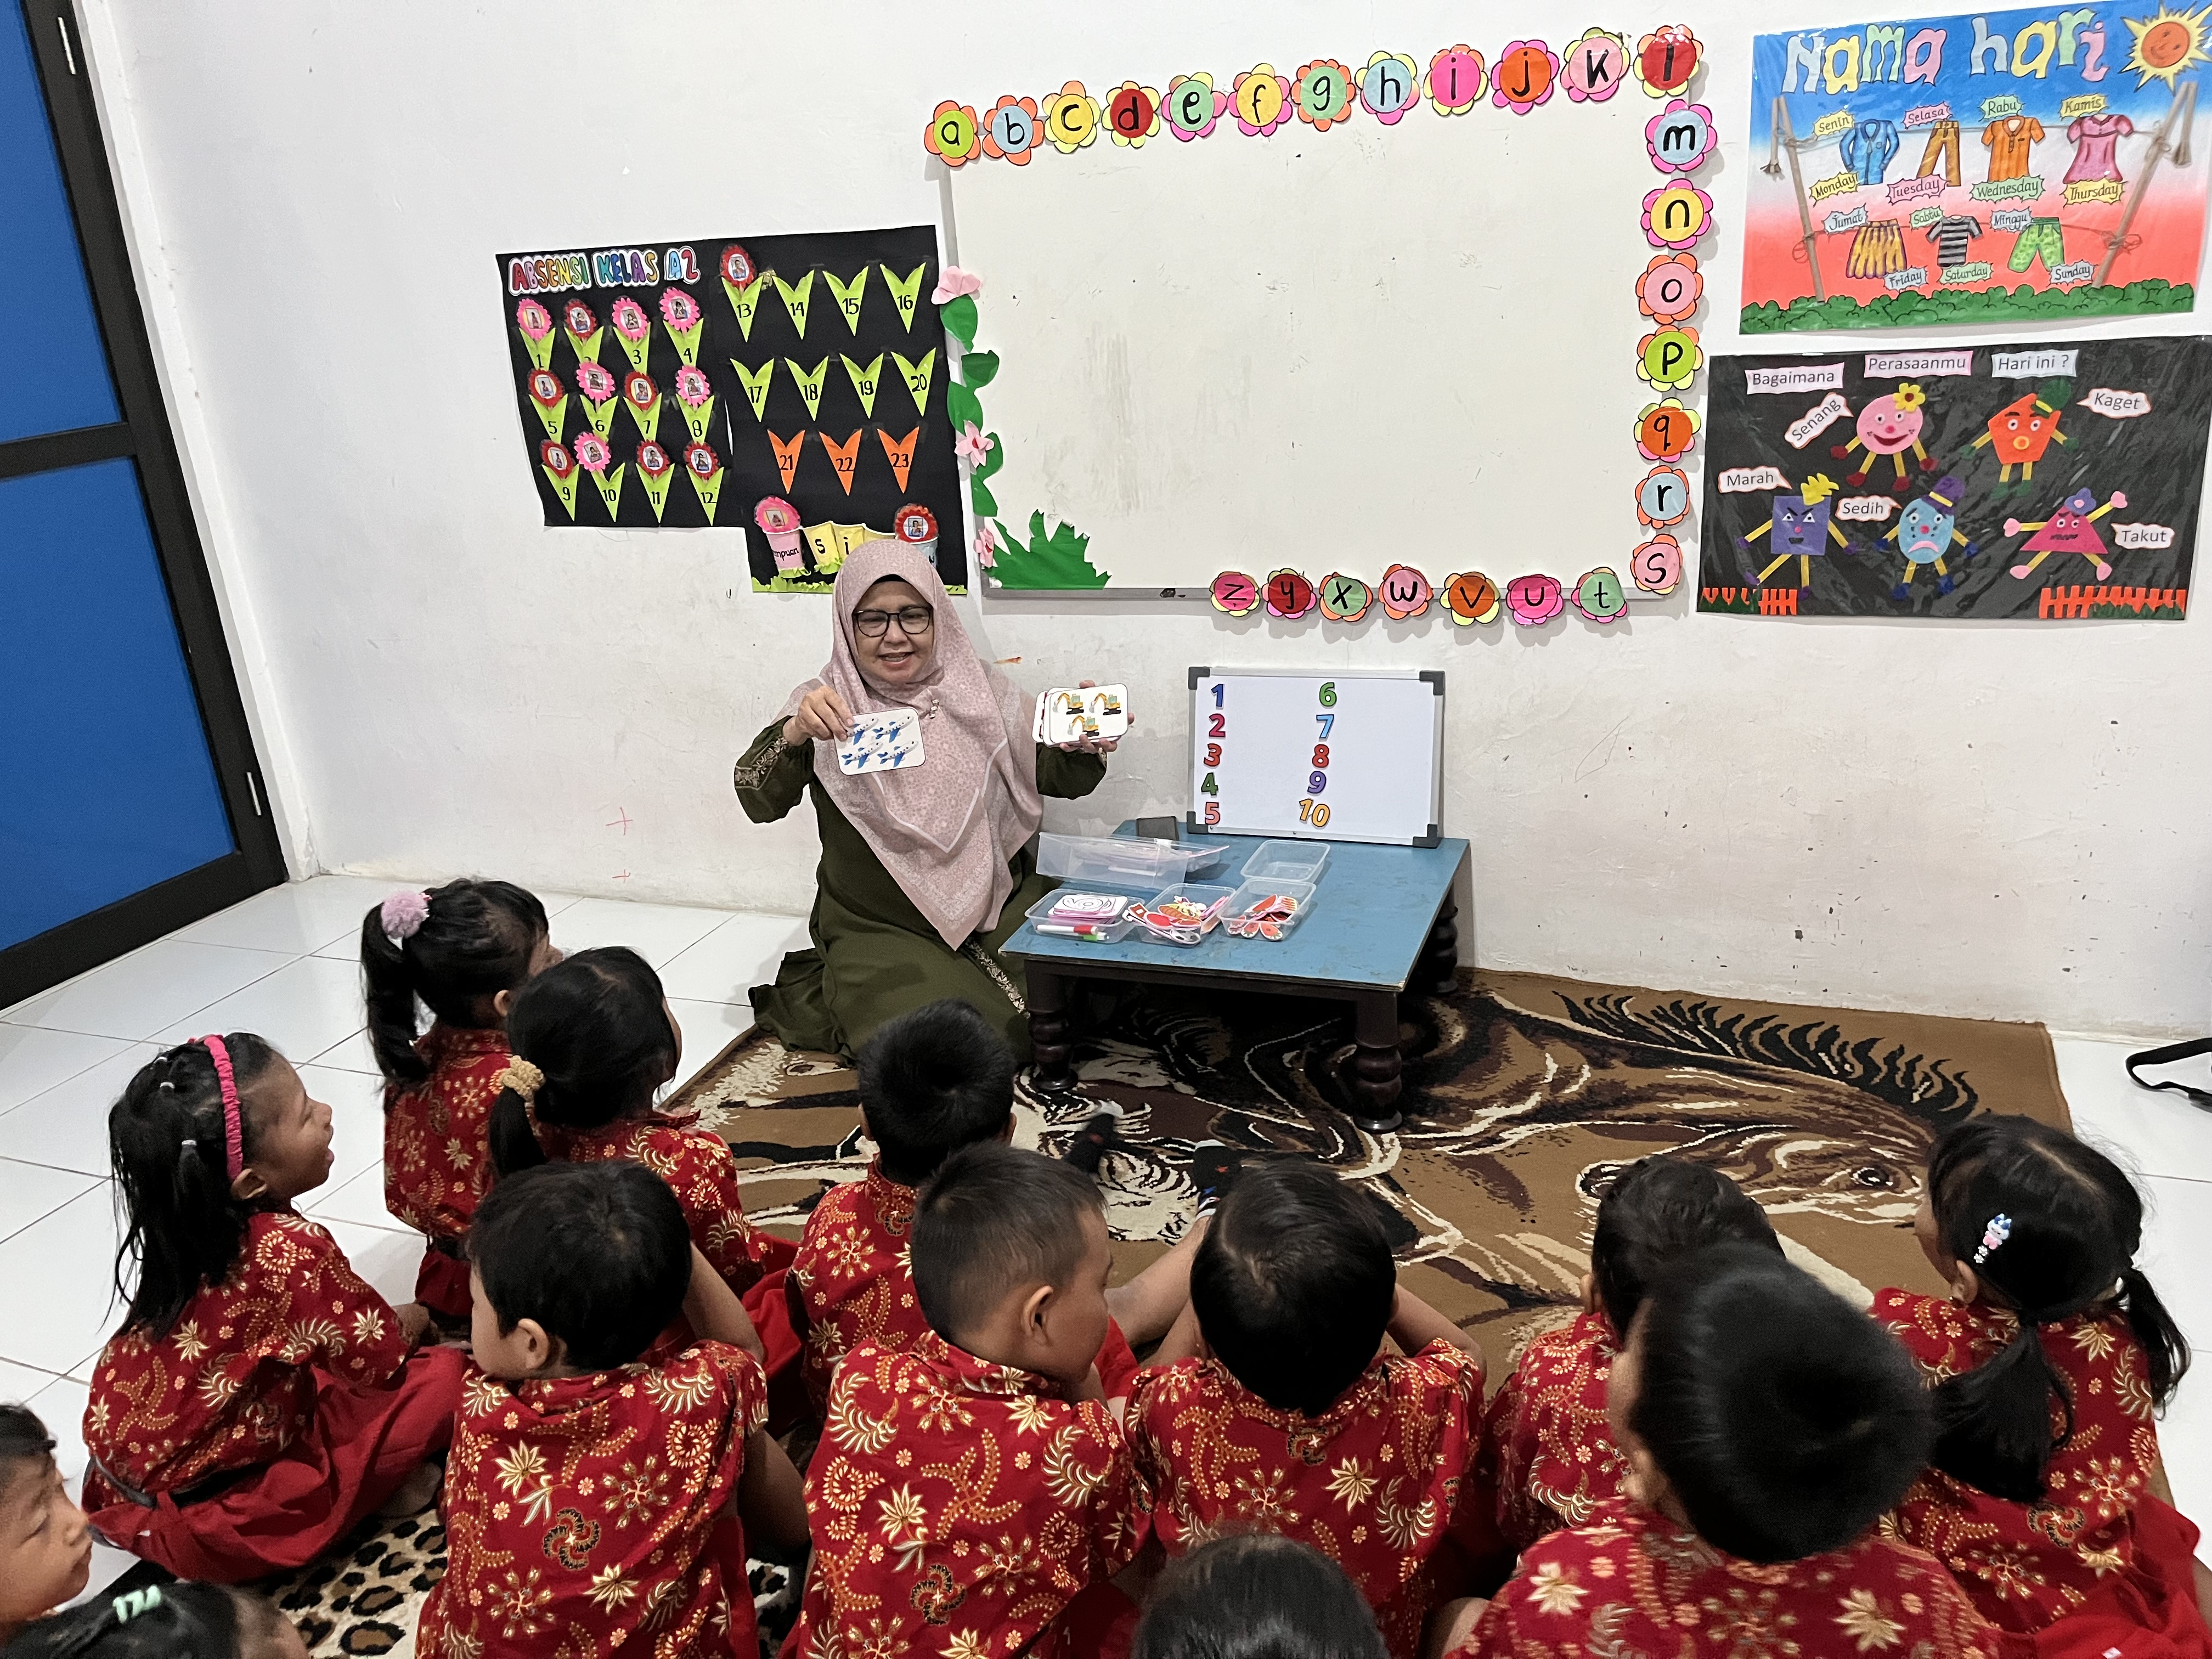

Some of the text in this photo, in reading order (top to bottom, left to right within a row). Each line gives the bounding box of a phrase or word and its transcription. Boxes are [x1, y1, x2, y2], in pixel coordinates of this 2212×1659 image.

[1781, 8, 2111, 95] Nama hari
[1451, 57, 1457, 100] i
[1511, 50, 1529, 97] j
[1312, 76, 1331, 110] g
[1380, 66, 1401, 106] h
[1182, 92, 1202, 125] e
[1252, 84, 1266, 123] f
[1988, 101, 2017, 114] Rabu
[2066, 97, 2102, 111] Kamis
[1118, 97, 1139, 131] d
[1908, 109, 1944, 123] Selasa
[941, 120, 961, 145] a
[1005, 113, 1025, 145] b
[1819, 117, 1850, 132] Senin
[1663, 125, 1696, 151] m
[1816, 176, 1856, 196] Monday
[1891, 177, 1940, 199] Tuesday
[1977, 180, 2038, 198] Wednesday
[2070, 184, 2119, 200] Thursday
[1665, 199, 1690, 229] n
[1829, 213, 1863, 230] Jumat
[1914, 210, 1940, 225] Sabtu
[1994, 213, 2027, 229] Minggu
[512, 250, 698, 290] ABSENSI KELAS A2
[1945, 265, 1988, 281] Saturday
[2055, 266, 2091, 281] Sunday
[1889, 270, 1922, 288] Friday
[736, 303, 752, 318] 13
[790, 302, 804, 317] 14
[842, 298, 859, 314] 15
[897, 295, 913, 310] 16
[537, 354, 544, 368] 1
[634, 349, 642, 364] 3
[684, 348, 692, 363] 4
[1753, 370, 1835, 387] Bagaimana
[1869, 357, 1965, 370] Perasaanmu
[1998, 356, 2030, 370] Hari
[2036, 356, 2056, 368] ini
[859, 380, 874, 396] 19
[911, 374, 927, 392] 20
[747, 386, 763, 403] 17
[803, 384, 819, 401] 18
[2094, 392, 2140, 410] Kaget
[548, 421, 557, 434] 5
[595, 420, 605, 432] 6
[643, 420, 651, 434] 7
[693, 420, 702, 437] 8
[1791, 399, 1841, 441] Senang
[1653, 415, 1671, 452] q
[780, 454, 793, 471] 21
[836, 457, 854, 472] 22
[891, 453, 909, 468] 23
[1727, 471, 1774, 486] Marah
[562, 487, 571, 501] 9
[603, 489, 617, 502] 10
[651, 492, 660, 505] 11
[701, 492, 716, 503] 12
[1657, 484, 1673, 512] r
[1843, 501, 1883, 514] Sedih
[2122, 530, 2166, 543] Takut
[1594, 582, 1610, 609] t
[1211, 684, 1224, 707] 1
[1319, 682, 1337, 707] 6
[1209, 713, 1226, 737] 2
[1317, 714, 1334, 738] 7
[1204, 743, 1222, 767] 3
[1312, 744, 1329, 768] 8
[1201, 772, 1218, 795] 4
[1307, 771, 1327, 793] 9
[1205, 802, 1220, 825] 5
[1299, 798, 1330, 827] 10
